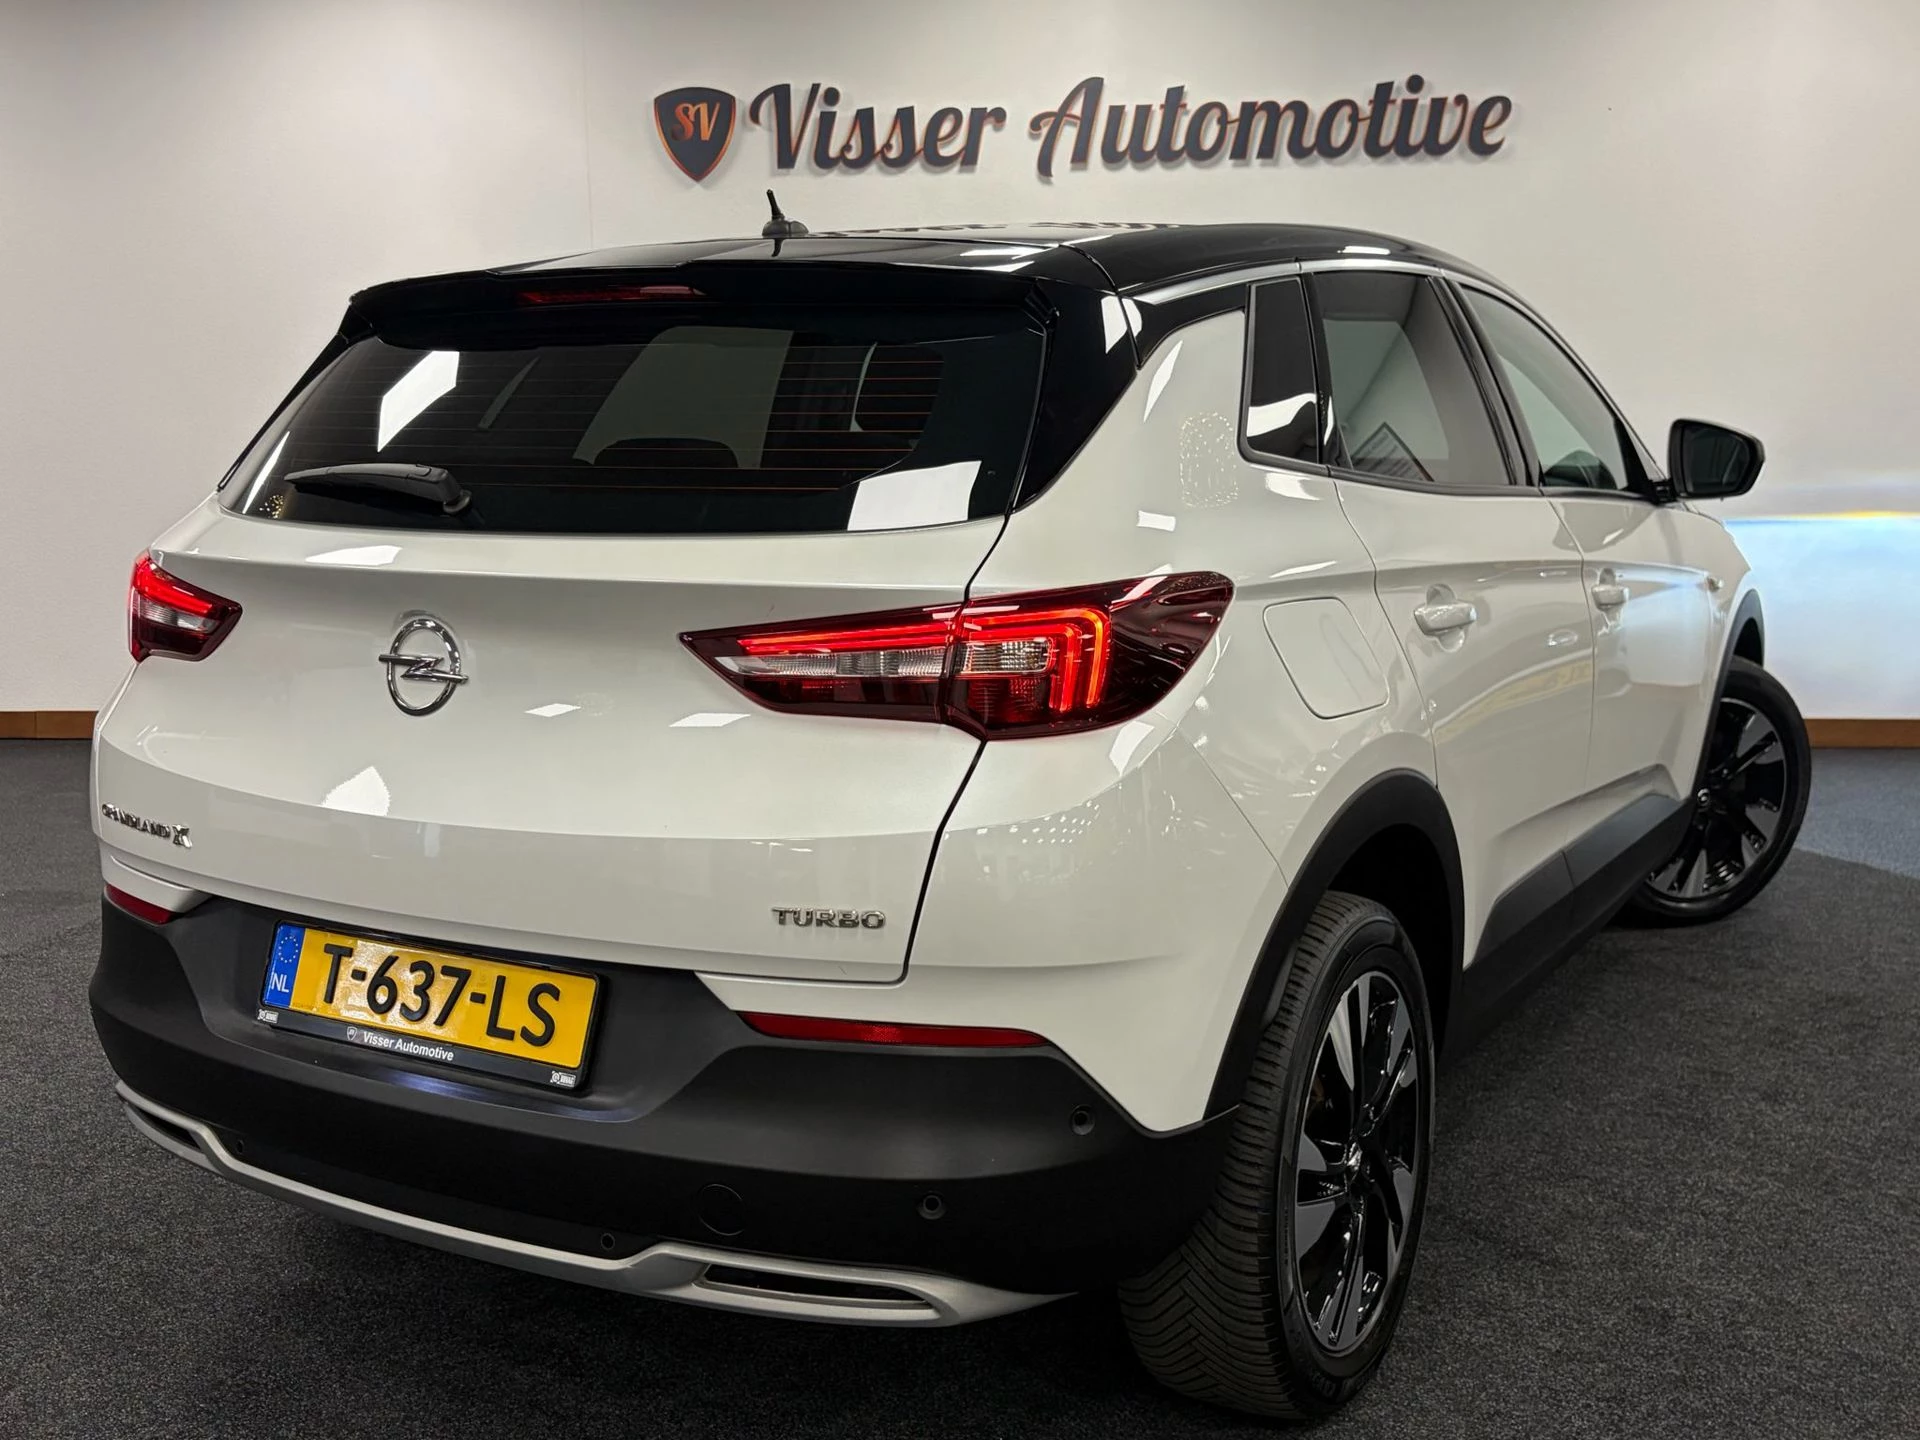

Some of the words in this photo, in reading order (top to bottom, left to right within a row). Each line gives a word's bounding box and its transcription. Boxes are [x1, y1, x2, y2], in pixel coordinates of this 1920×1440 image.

[670, 101, 721, 142] SV
[749, 83, 1008, 170] Visser
[1028, 74, 1513, 178] Automotive
[771, 906, 886, 929] TURBO
[270, 972, 290, 994] NL
[323, 943, 562, 1048] T-637-LS
[363, 1031, 395, 1049] Visser
[394, 1038, 455, 1061] Automotive
